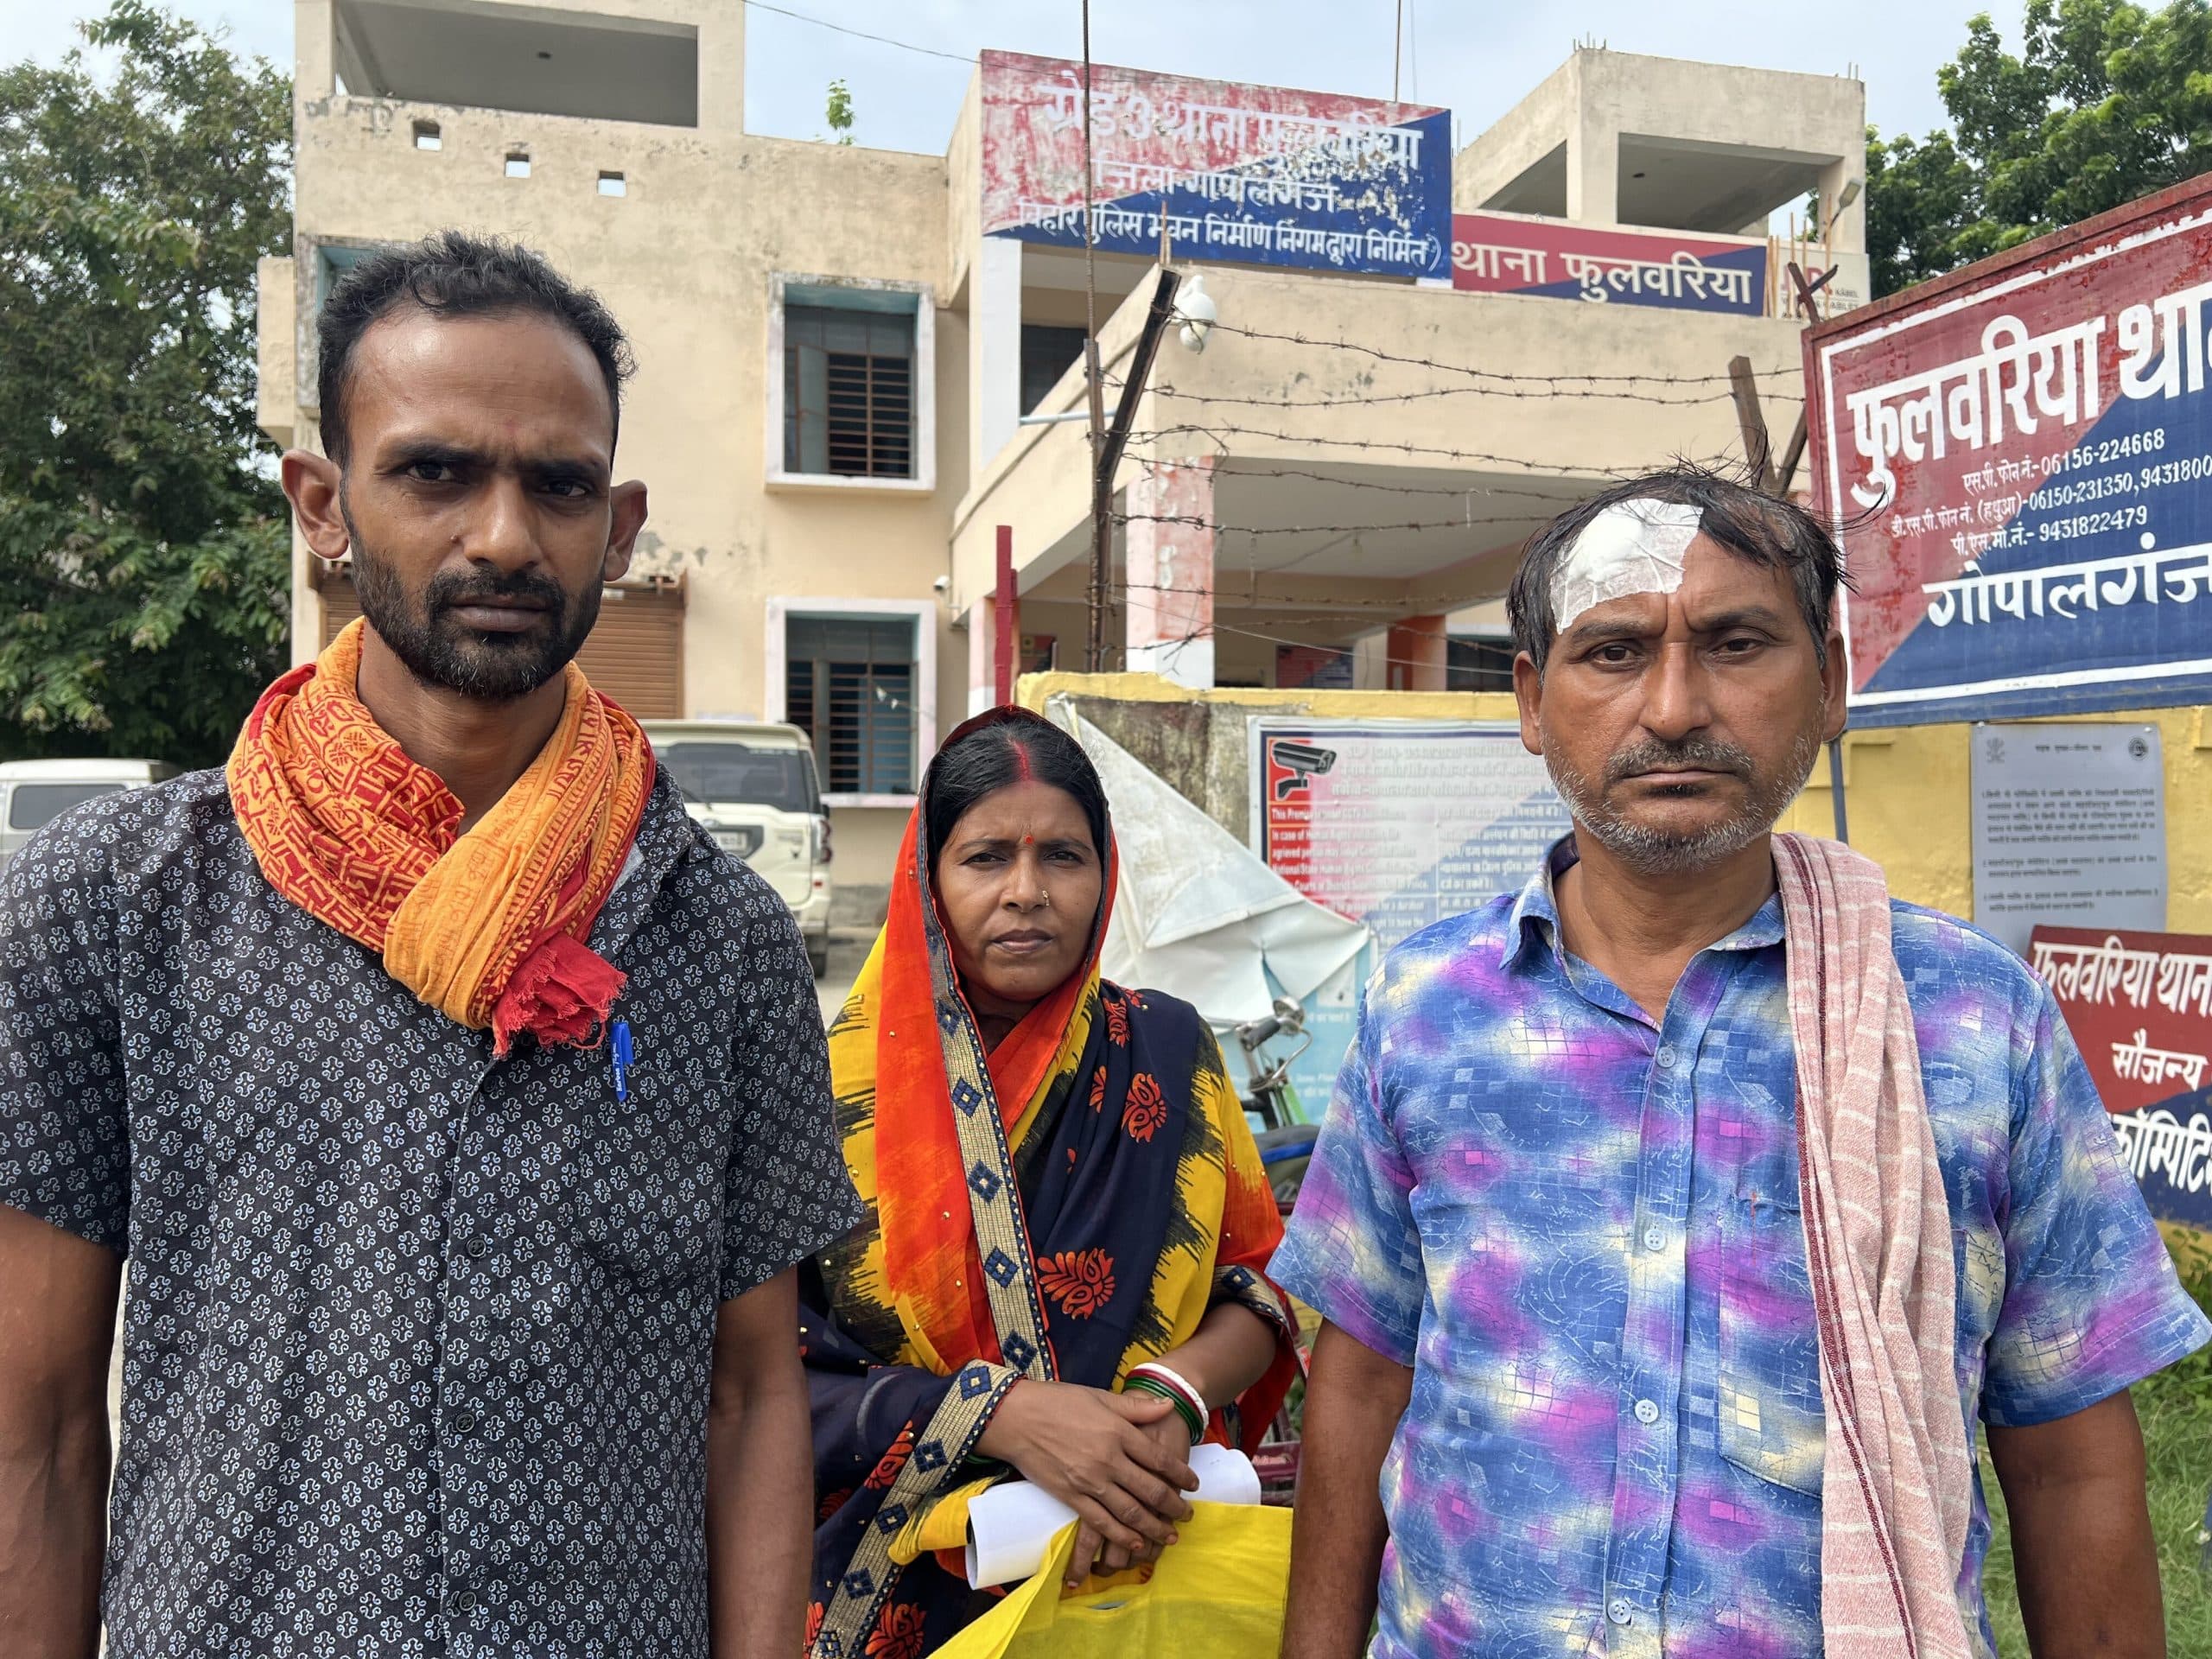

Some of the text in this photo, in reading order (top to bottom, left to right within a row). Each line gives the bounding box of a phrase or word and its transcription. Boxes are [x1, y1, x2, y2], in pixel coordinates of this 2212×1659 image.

[1452, 240, 1753, 304] थाना फुलवरिया
[1846, 314, 2107, 509] फुलवरिया
[1922, 531, 2212, 627] गोपालगंज
[2033, 935, 2212, 1018] फलवरिया थान
[2111, 1028, 2209, 1091] सौजन्य
